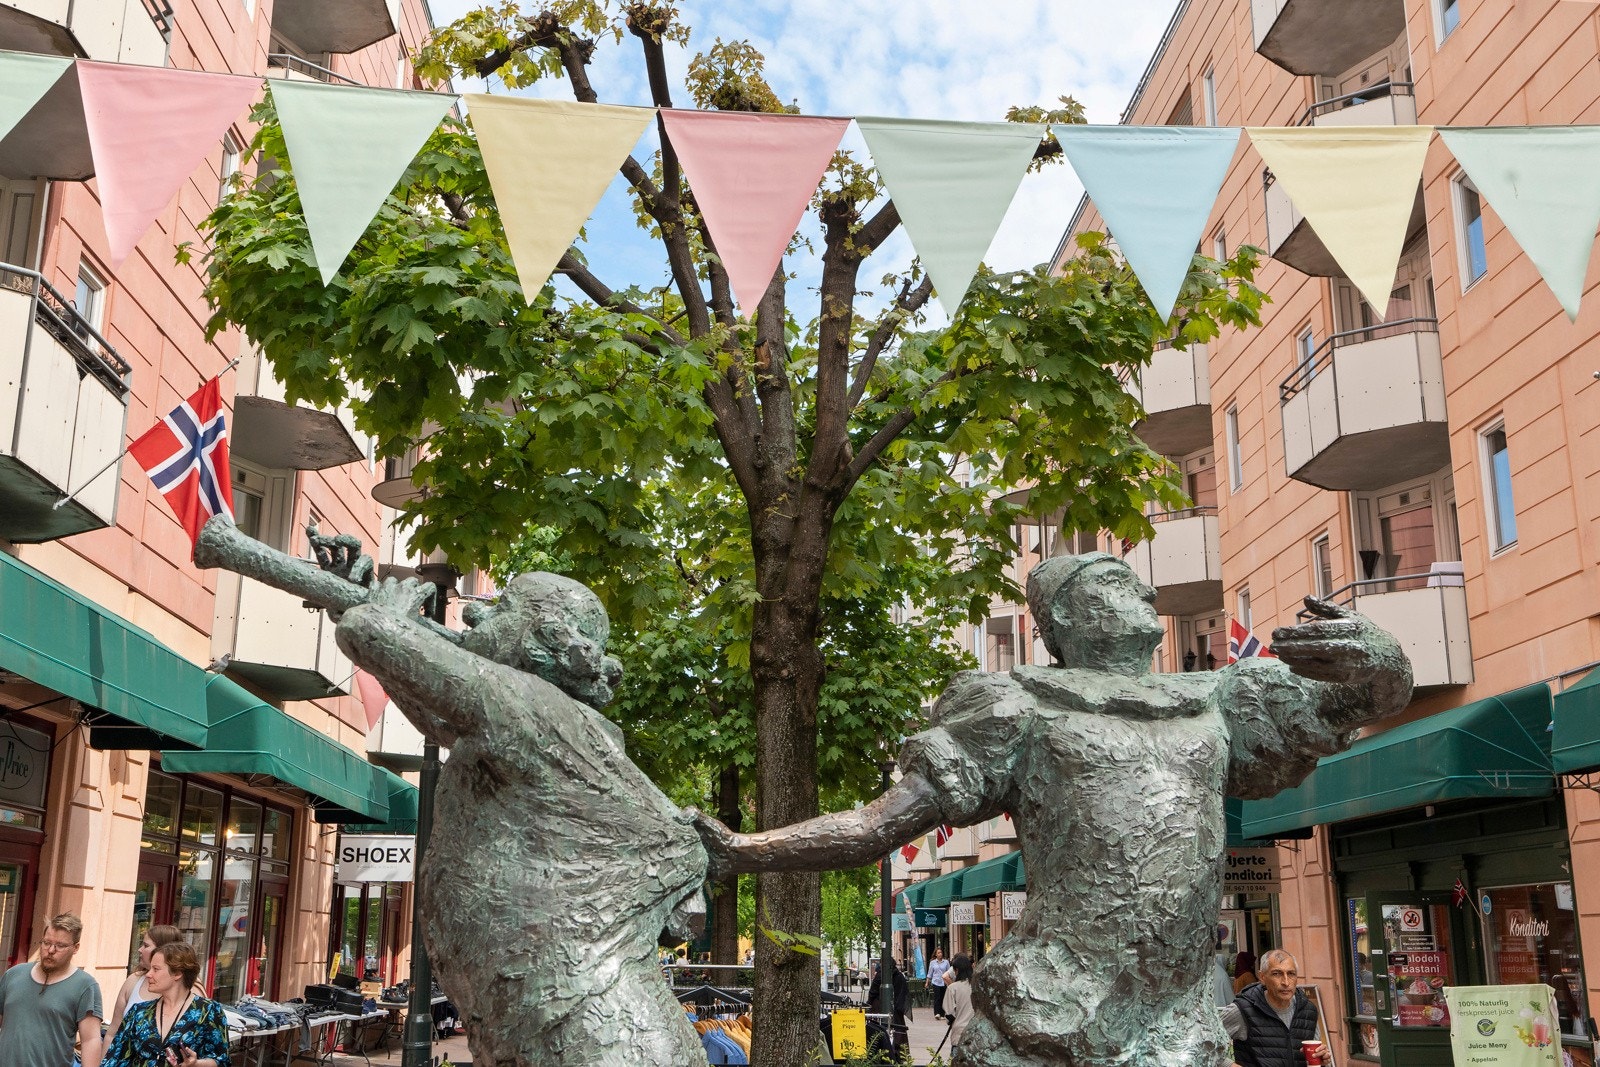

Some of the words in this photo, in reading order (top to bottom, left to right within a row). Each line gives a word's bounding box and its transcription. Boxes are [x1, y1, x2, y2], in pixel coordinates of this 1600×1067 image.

[342, 847, 411, 863] SHOEX
[1224, 868, 1272, 880] onditori
[1006, 905, 1023, 914] TEK
[1509, 917, 1549, 936] Konditori
[1407, 954, 1440, 963] alodeh
[1402, 965, 1440, 973] Bastani
[840, 1041, 860, 1050] 19.-
